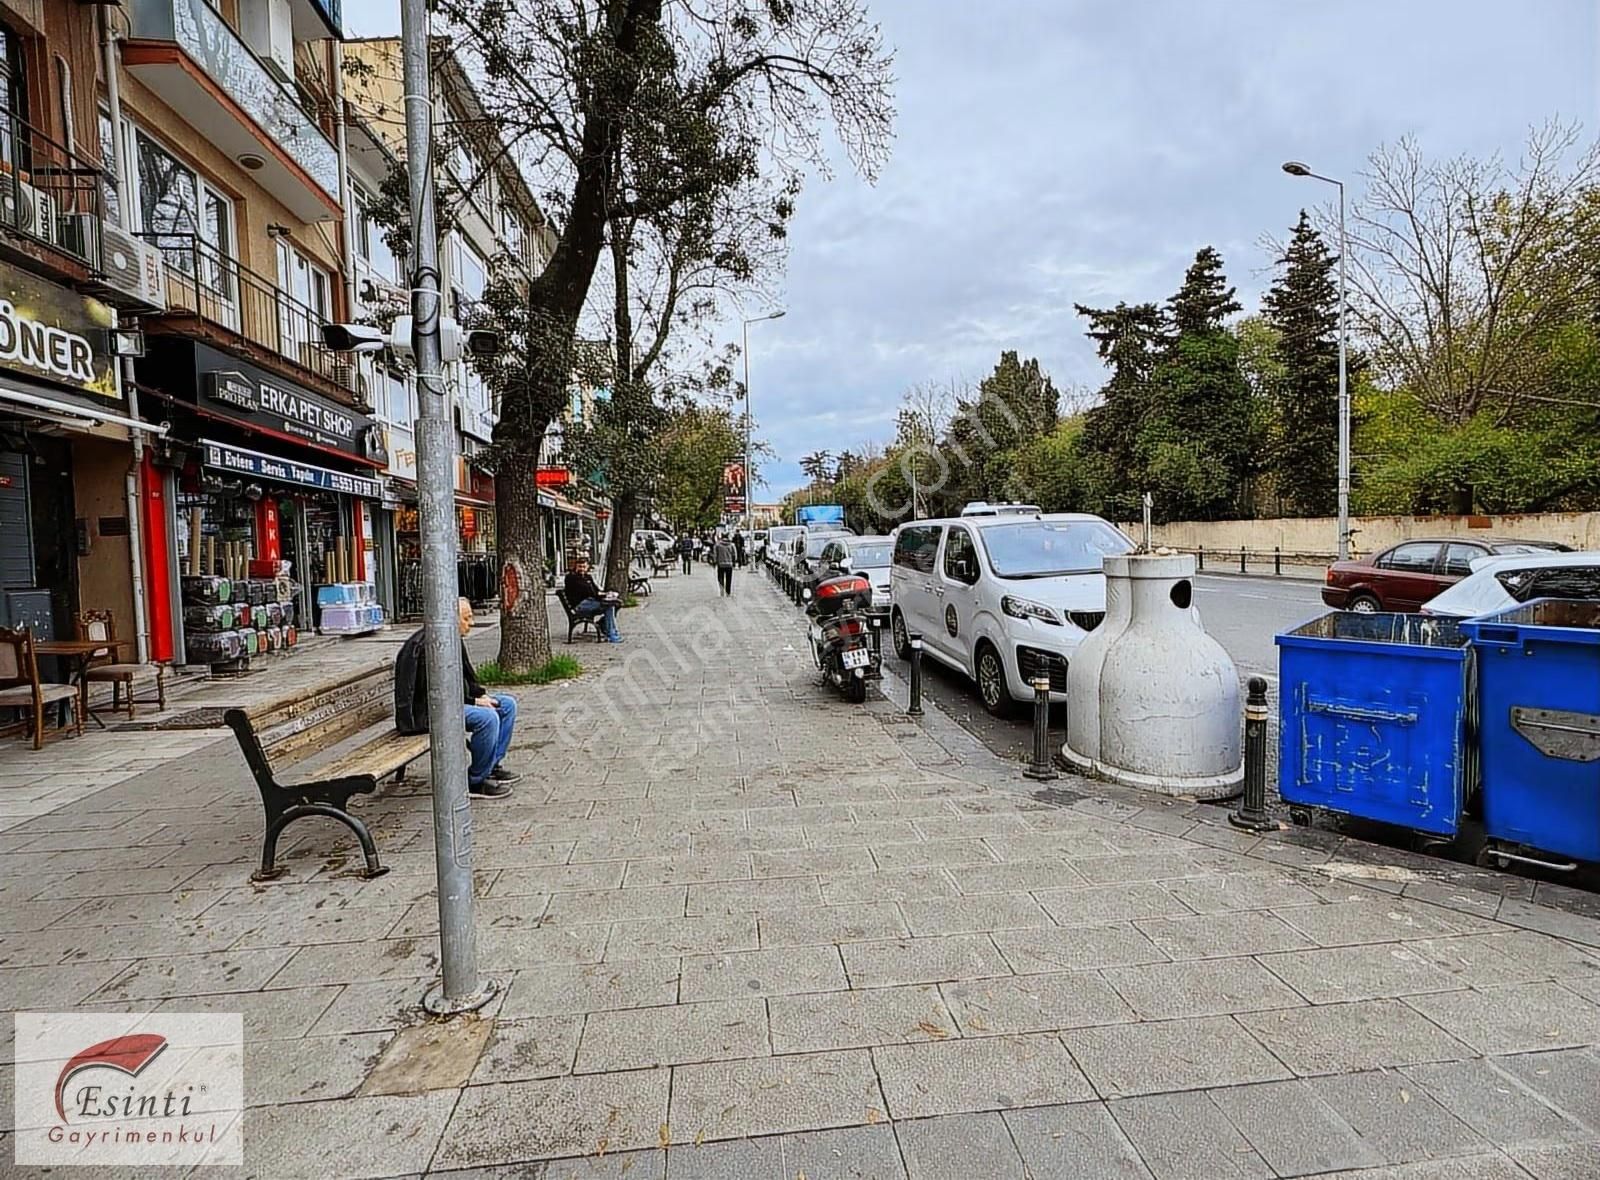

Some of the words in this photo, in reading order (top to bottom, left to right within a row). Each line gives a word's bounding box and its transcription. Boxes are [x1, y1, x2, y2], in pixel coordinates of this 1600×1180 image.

[260, 384, 299, 419] ERKA
[300, 399, 322, 427] PET
[323, 410, 352, 437] SHOP
[261, 460, 286, 479] Servis
